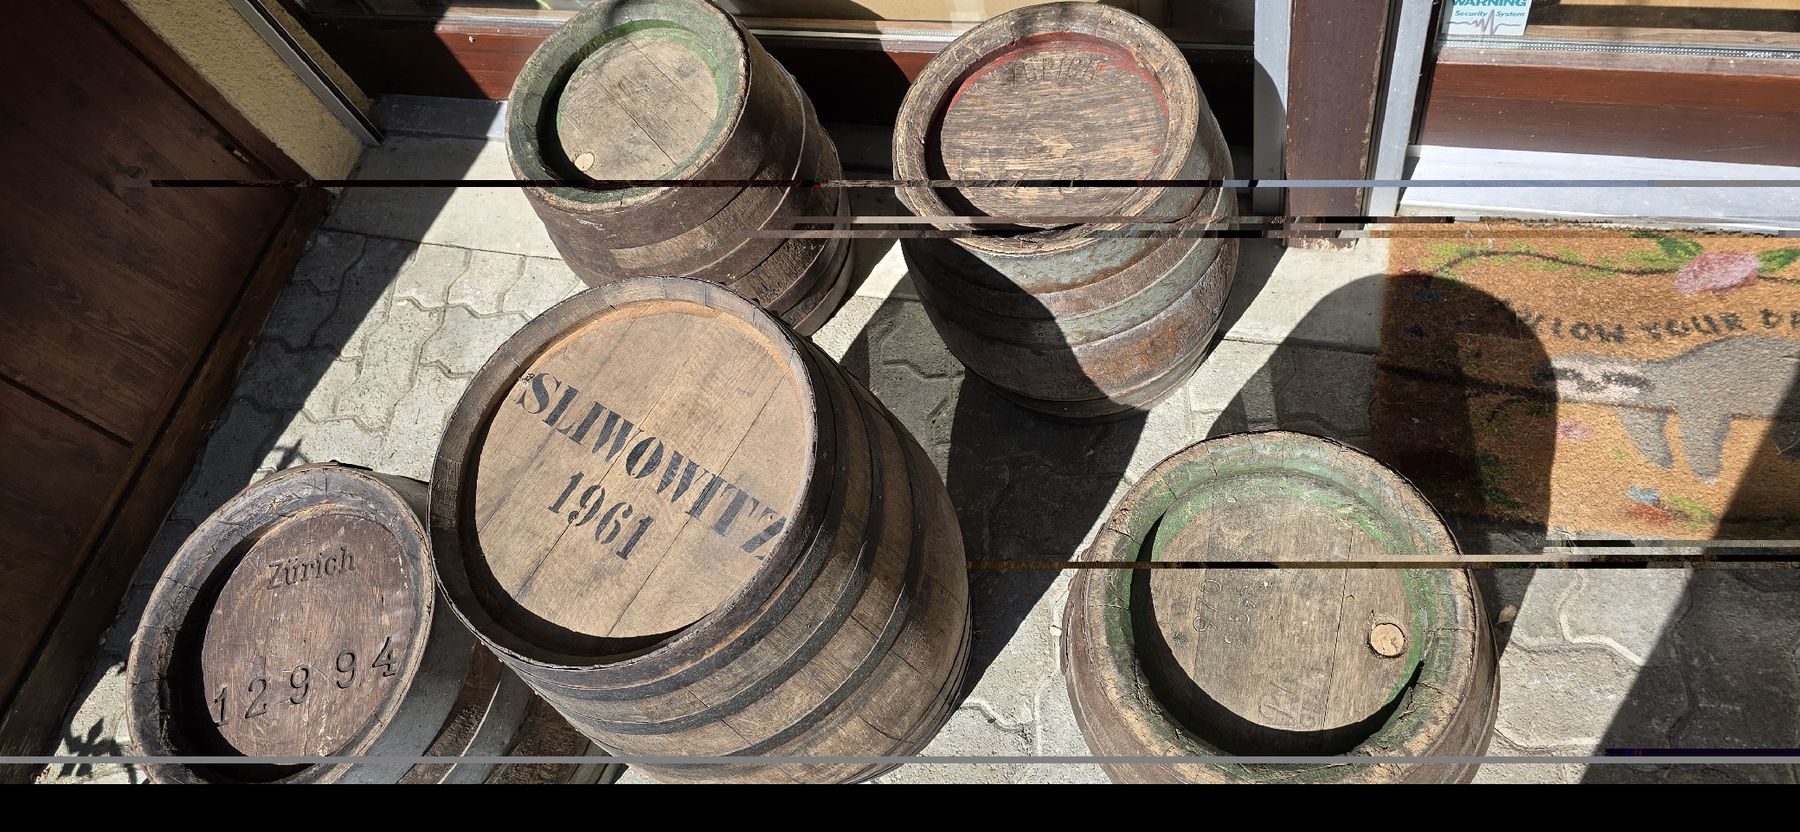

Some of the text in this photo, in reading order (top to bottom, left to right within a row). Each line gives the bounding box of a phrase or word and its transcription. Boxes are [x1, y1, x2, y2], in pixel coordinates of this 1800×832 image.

[516, 372, 789, 561] SLIWOWITZ
[548, 471, 654, 561] 1961
[266, 547, 357, 590] Zürich
[213, 636, 396, 727] 12994
